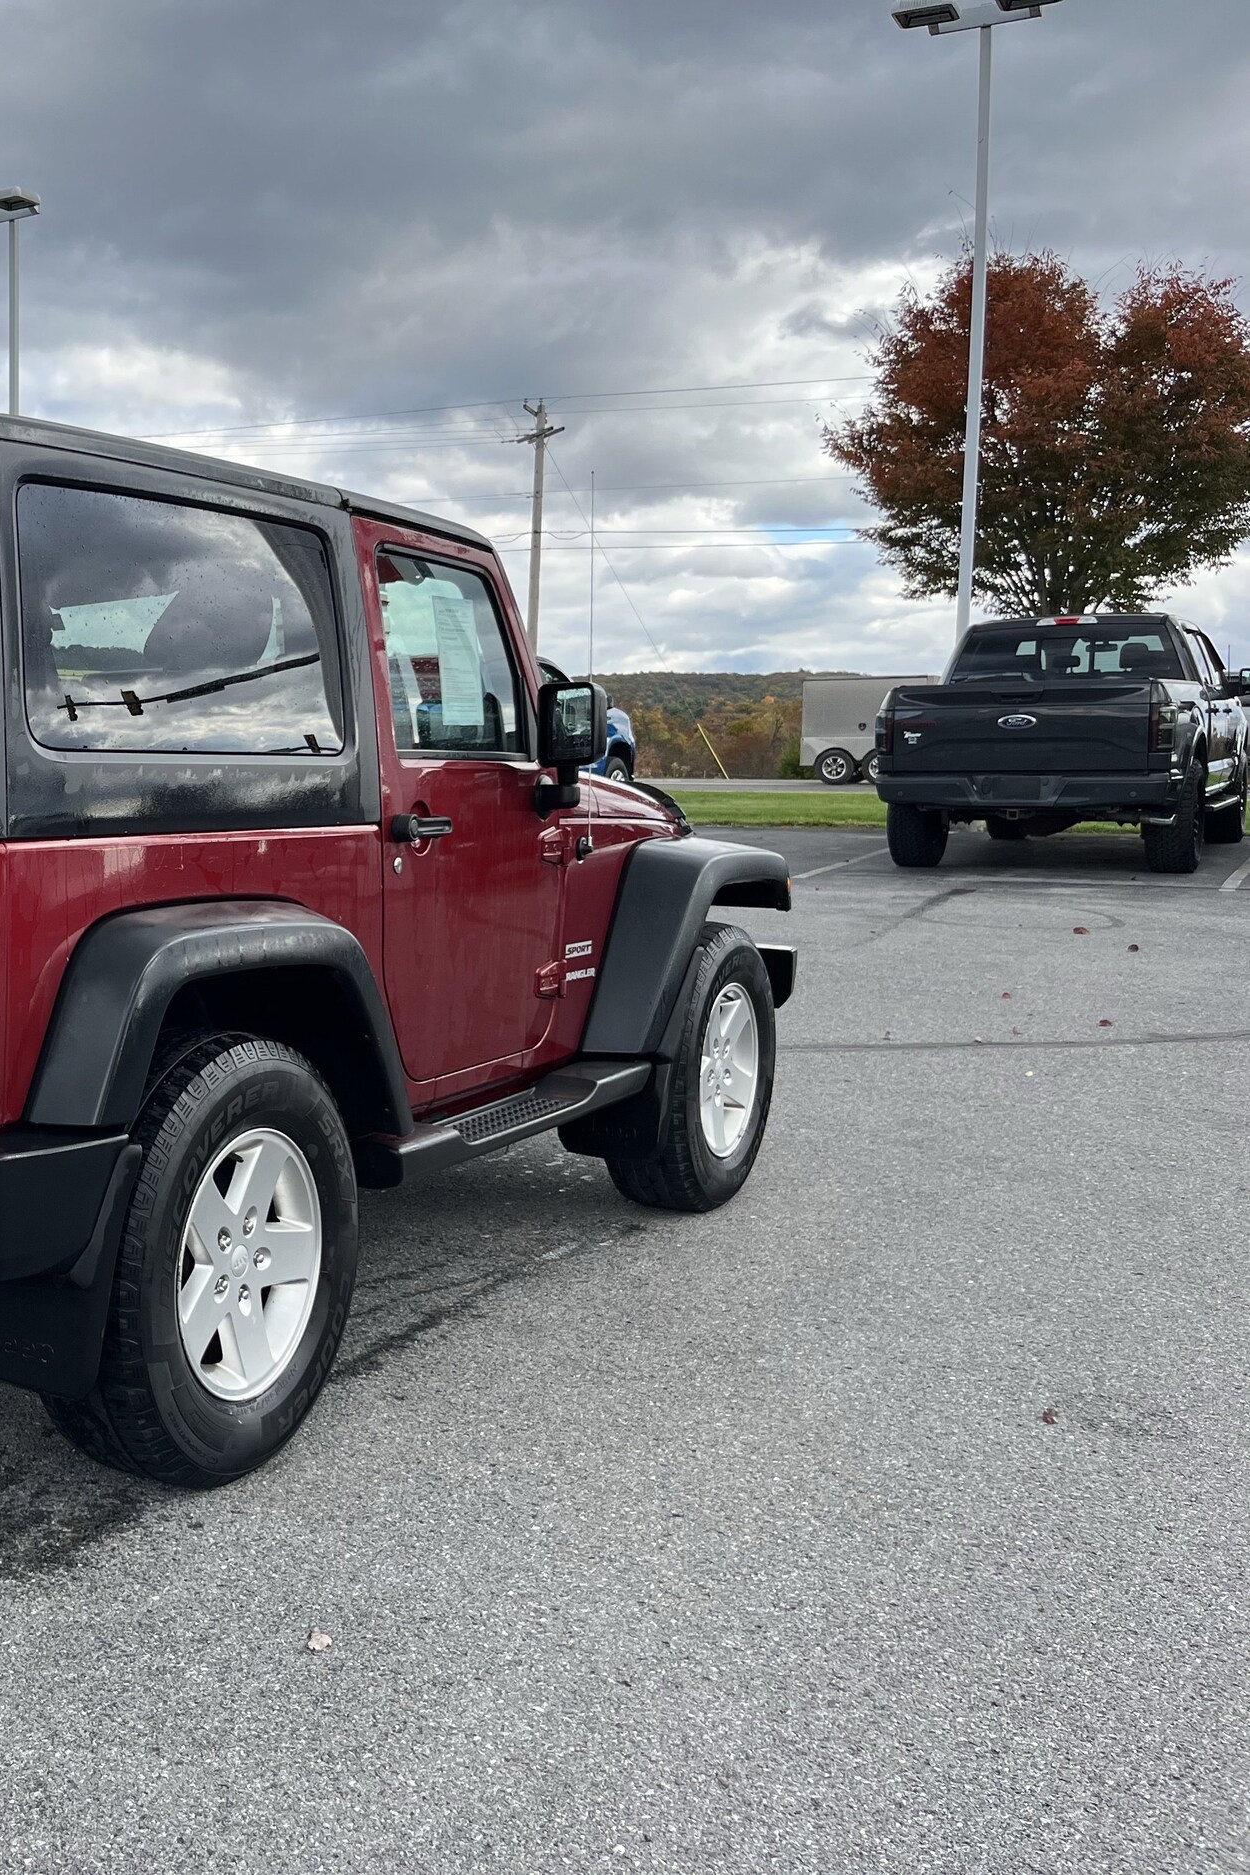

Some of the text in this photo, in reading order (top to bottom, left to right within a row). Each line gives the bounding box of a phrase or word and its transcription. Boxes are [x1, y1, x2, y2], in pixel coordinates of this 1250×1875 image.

[565, 943, 592, 956] SPORT
[565, 967, 596, 982] RANGLER
[317, 1111, 352, 1185] SRX
[158, 1080, 280, 1309] DISCOVERER
[277, 1270, 352, 1438] COOPER
